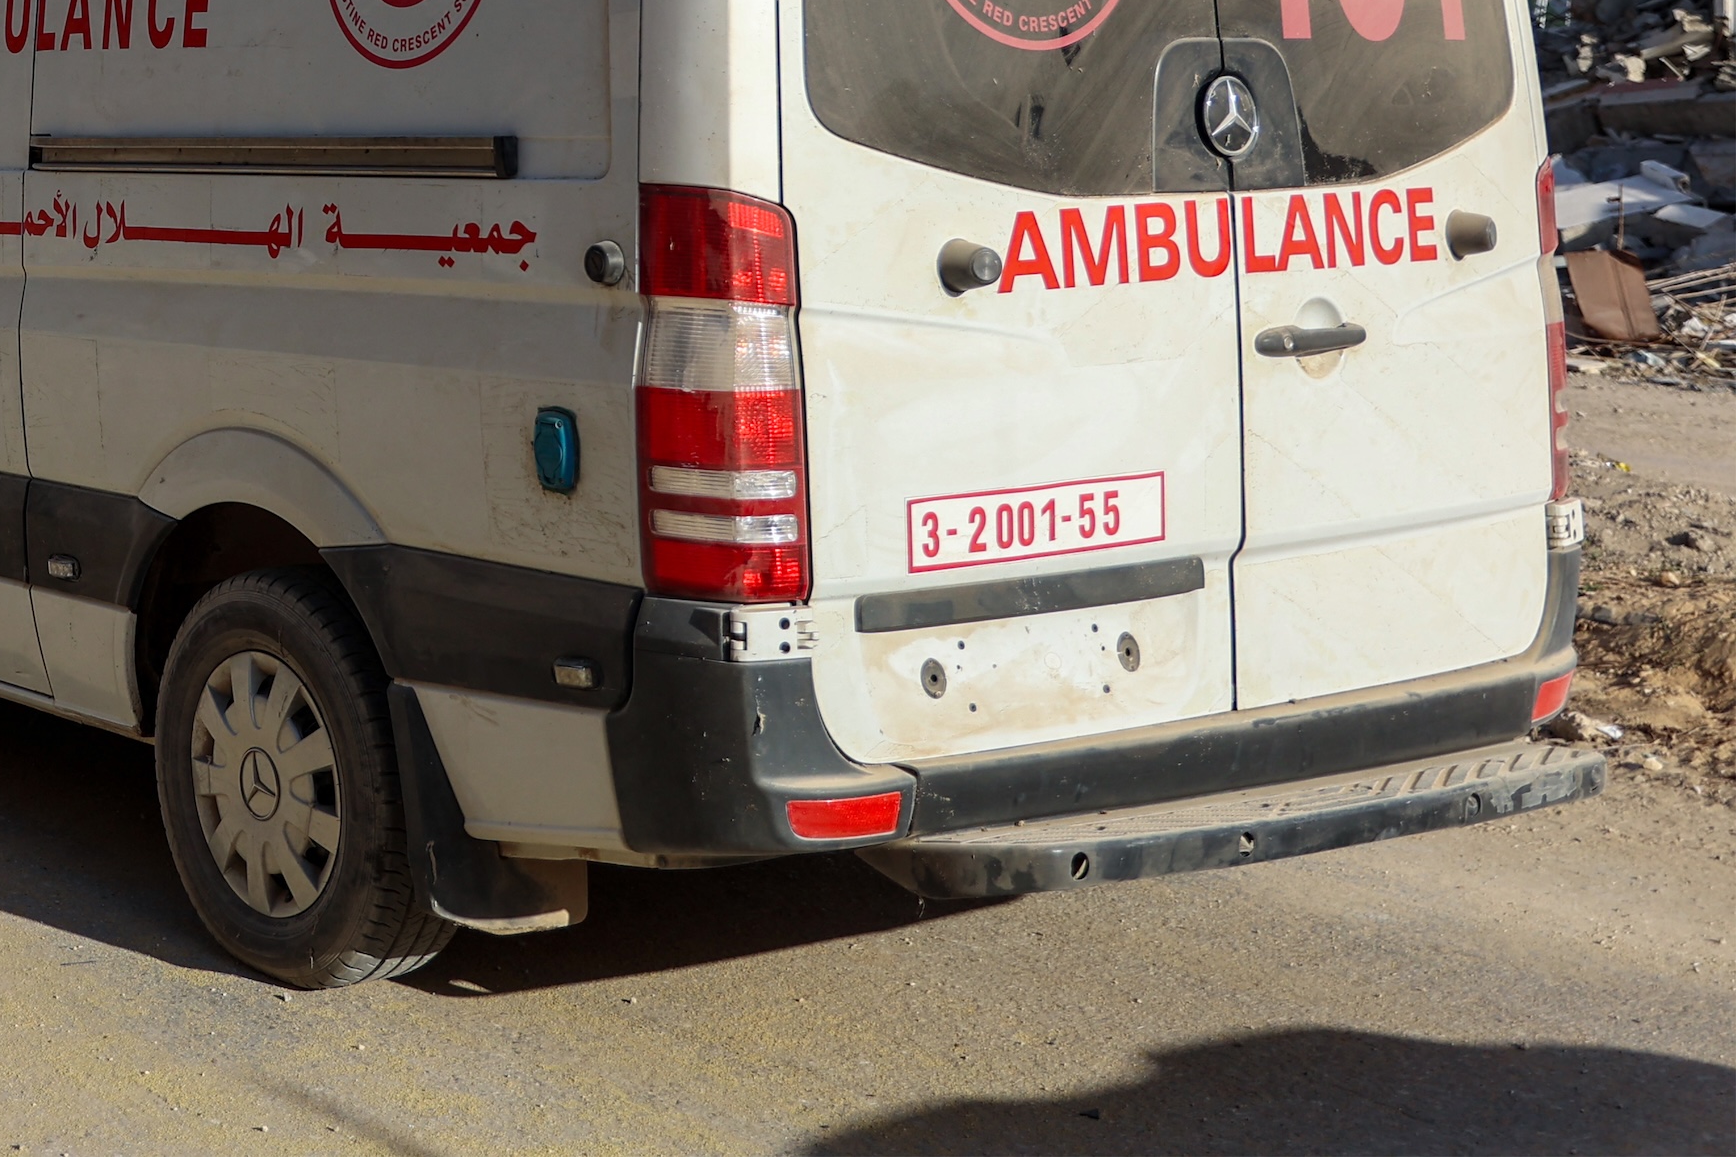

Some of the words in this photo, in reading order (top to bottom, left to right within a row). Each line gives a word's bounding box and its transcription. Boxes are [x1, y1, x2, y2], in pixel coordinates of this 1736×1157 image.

[367, 28, 389, 50] RED
[392, 12, 452, 52] CRESCENT
[982, 0, 1013, 27] RED
[83, 200, 305, 259] الهلال
[322, 203, 537, 272] جمعية
[998, 188, 1439, 295] AMBULANCE
[922, 490, 1120, 559] 3-2001-55
